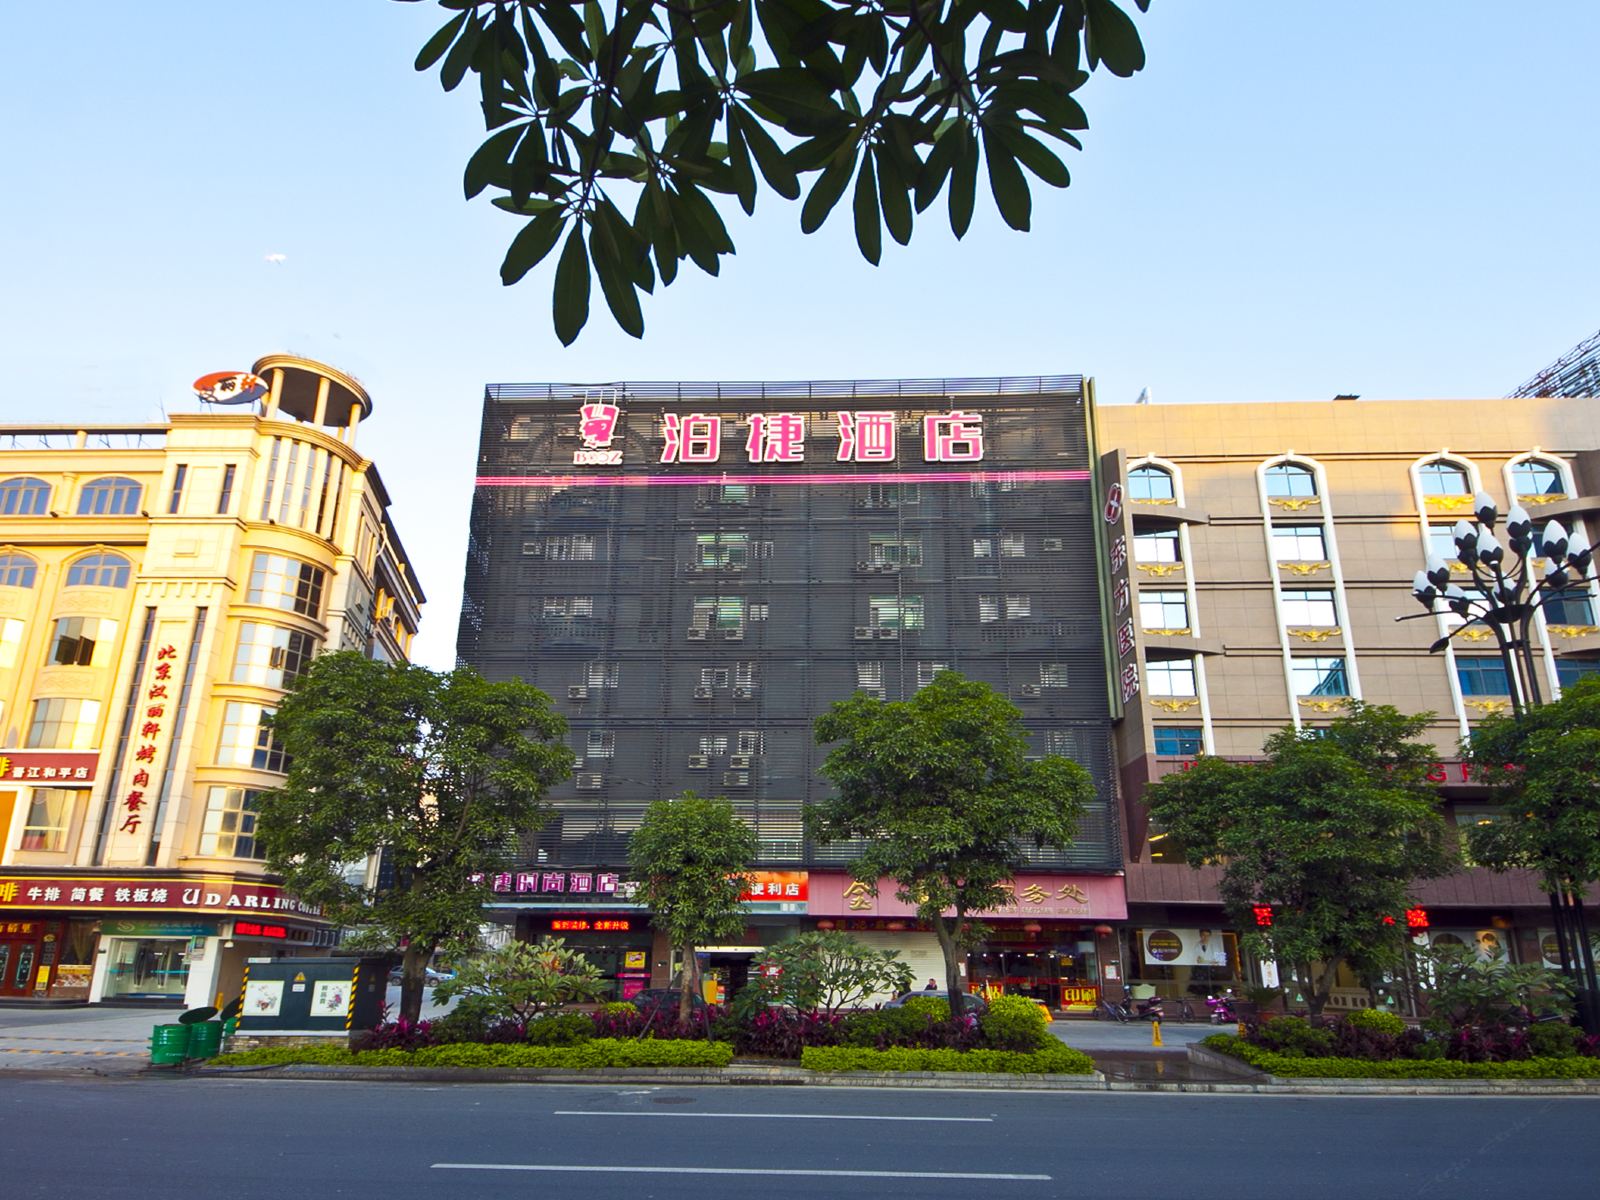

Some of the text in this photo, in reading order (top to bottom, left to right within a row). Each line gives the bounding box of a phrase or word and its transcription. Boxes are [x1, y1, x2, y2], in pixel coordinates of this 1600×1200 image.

[660, 410, 985, 464] 泊捷酒店
[1110, 535, 1140, 704] 东方医院
[119, 644, 177, 835] 北京汉丽轩烤肉餐厅
[12, 766, 89, 779] 晋江和平店
[27, 886, 62, 902] 牛排
[70, 887, 105, 902] 简餐
[114, 887, 169, 904] 铁板烧
[750, 882, 801, 896] 便利店
